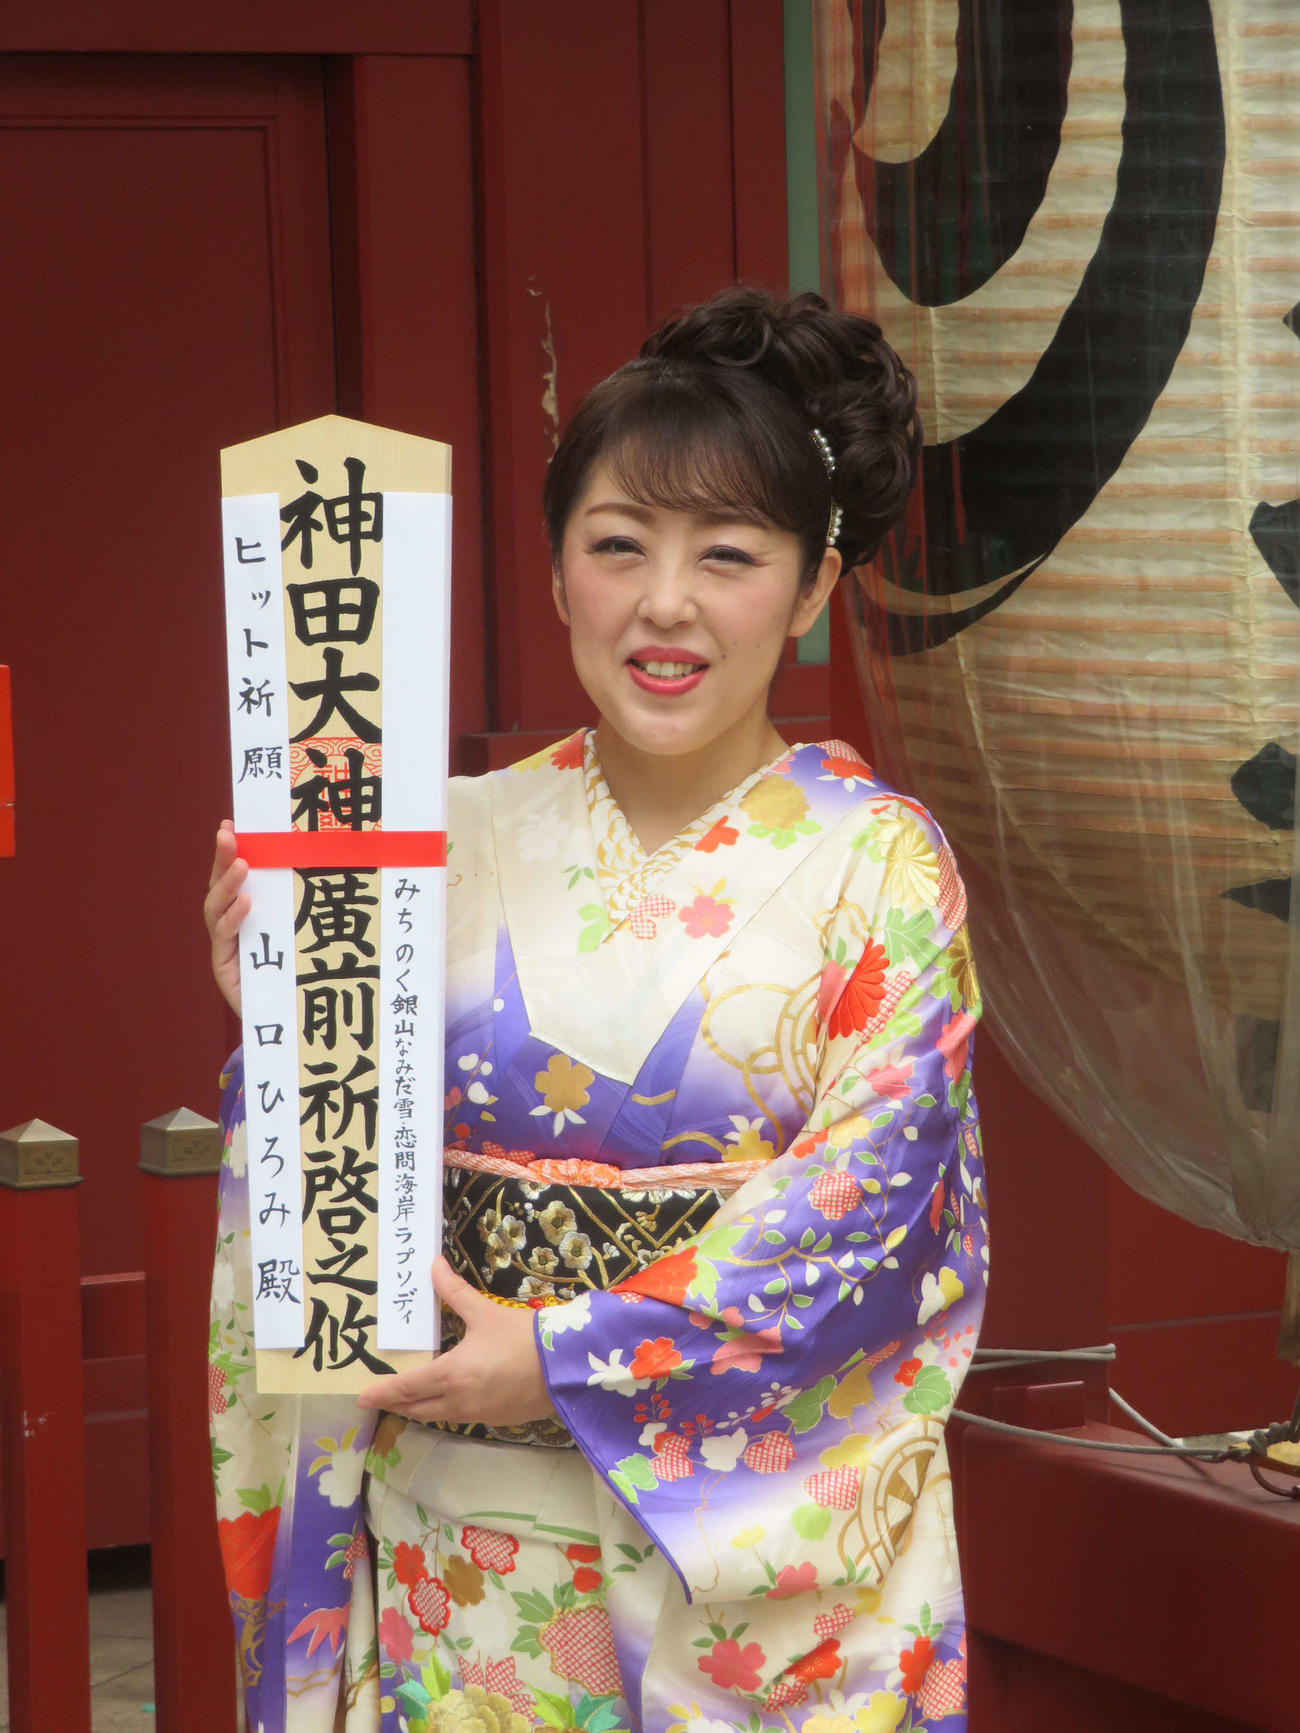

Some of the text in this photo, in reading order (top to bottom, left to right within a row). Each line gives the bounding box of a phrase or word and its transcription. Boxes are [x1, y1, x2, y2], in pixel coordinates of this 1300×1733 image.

[235, 537, 300, 1304] ヒット祈願 山口ひろみ殿
